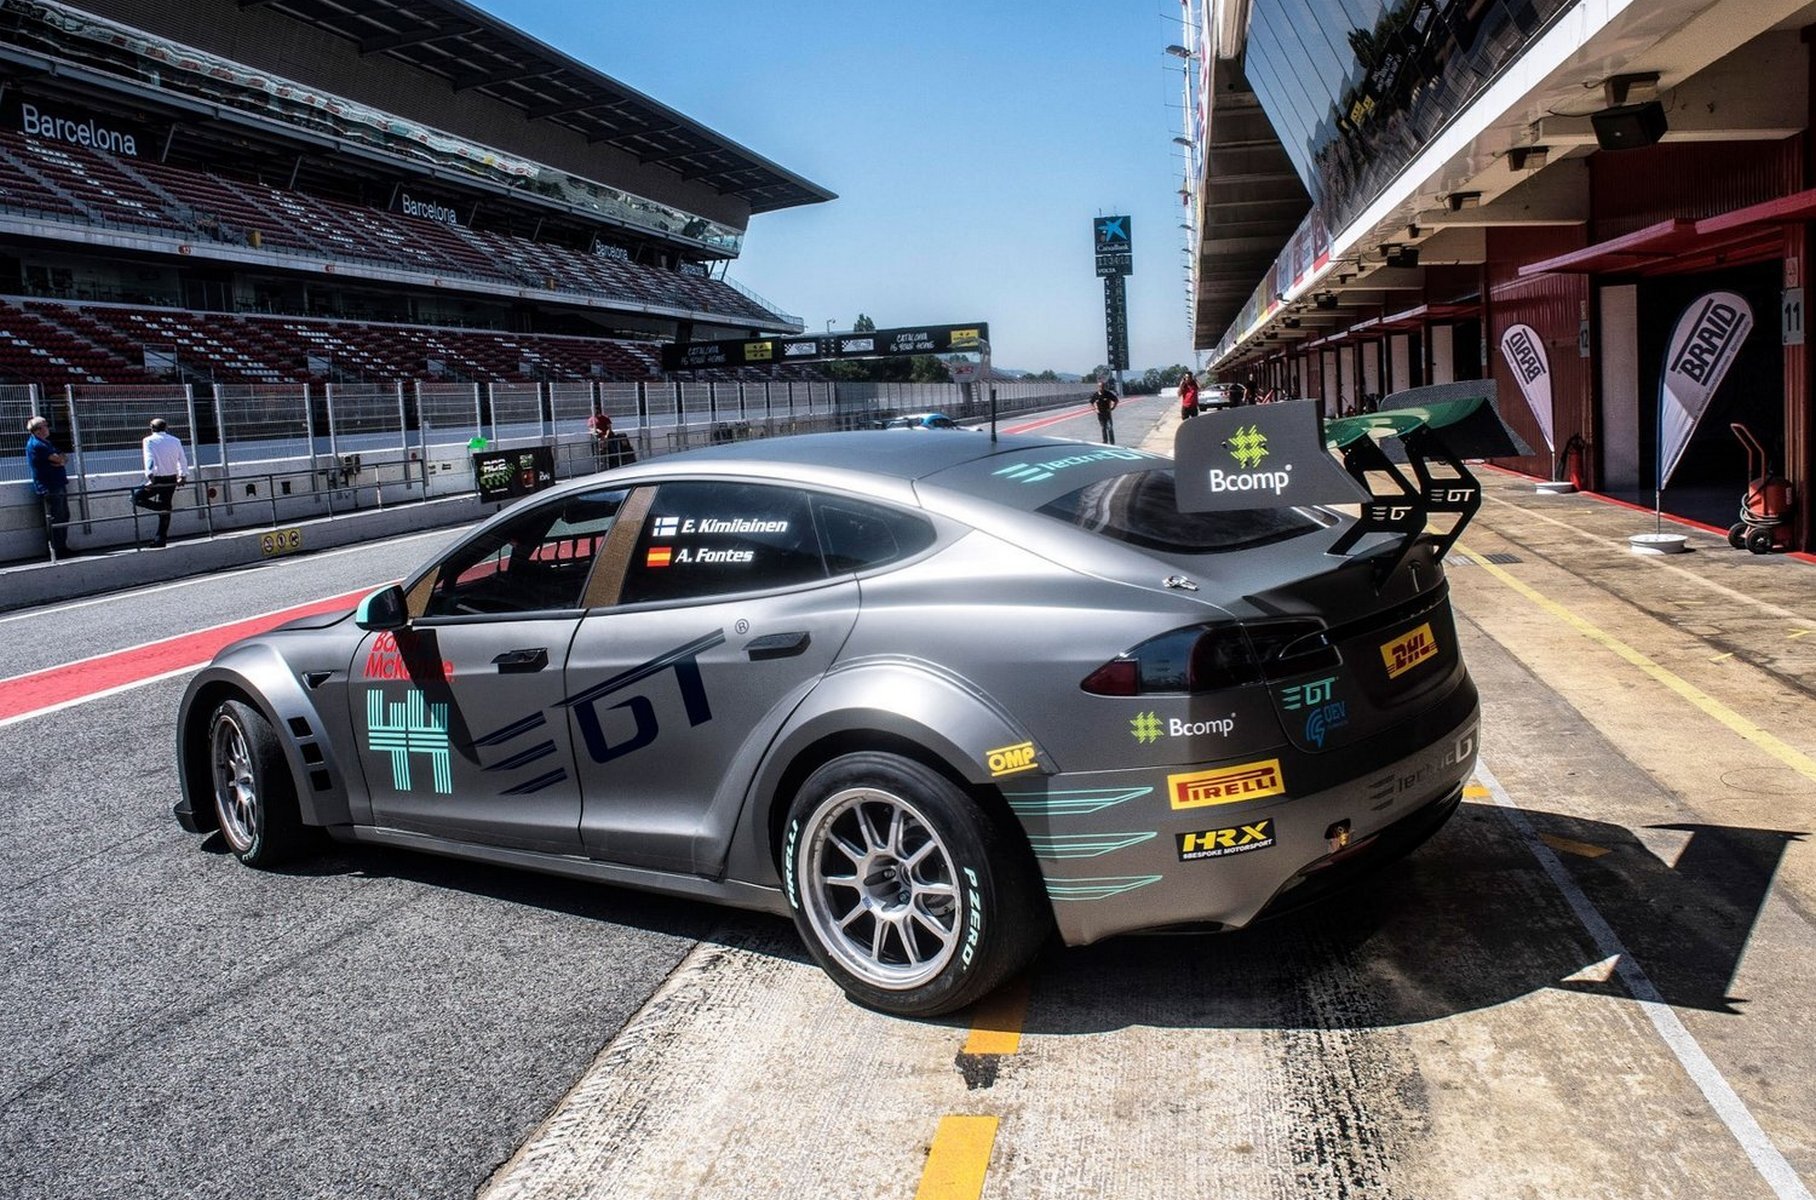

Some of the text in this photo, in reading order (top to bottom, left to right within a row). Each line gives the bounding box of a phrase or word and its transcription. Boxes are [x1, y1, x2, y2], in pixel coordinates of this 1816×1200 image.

[22, 103, 137, 155] Barcelona
[402, 193, 457, 224] Barcelona
[1785, 302, 1800, 332] 11
[1679, 303, 1737, 383] BRAID
[681, 518, 788, 534] E. Kimilainen
[675, 548, 754, 563] A. Fontes
[1391, 632, 1430, 669] DHL
[988, 746, 1035, 772] OMP
[1177, 767, 1277, 803] PIRELLI
[1183, 821, 1268, 852] HRX
[1223, 838, 1273, 855] MOTORSPORT
[783, 819, 799, 909] PIRELLI
[960, 867, 981, 966] P ZERO
